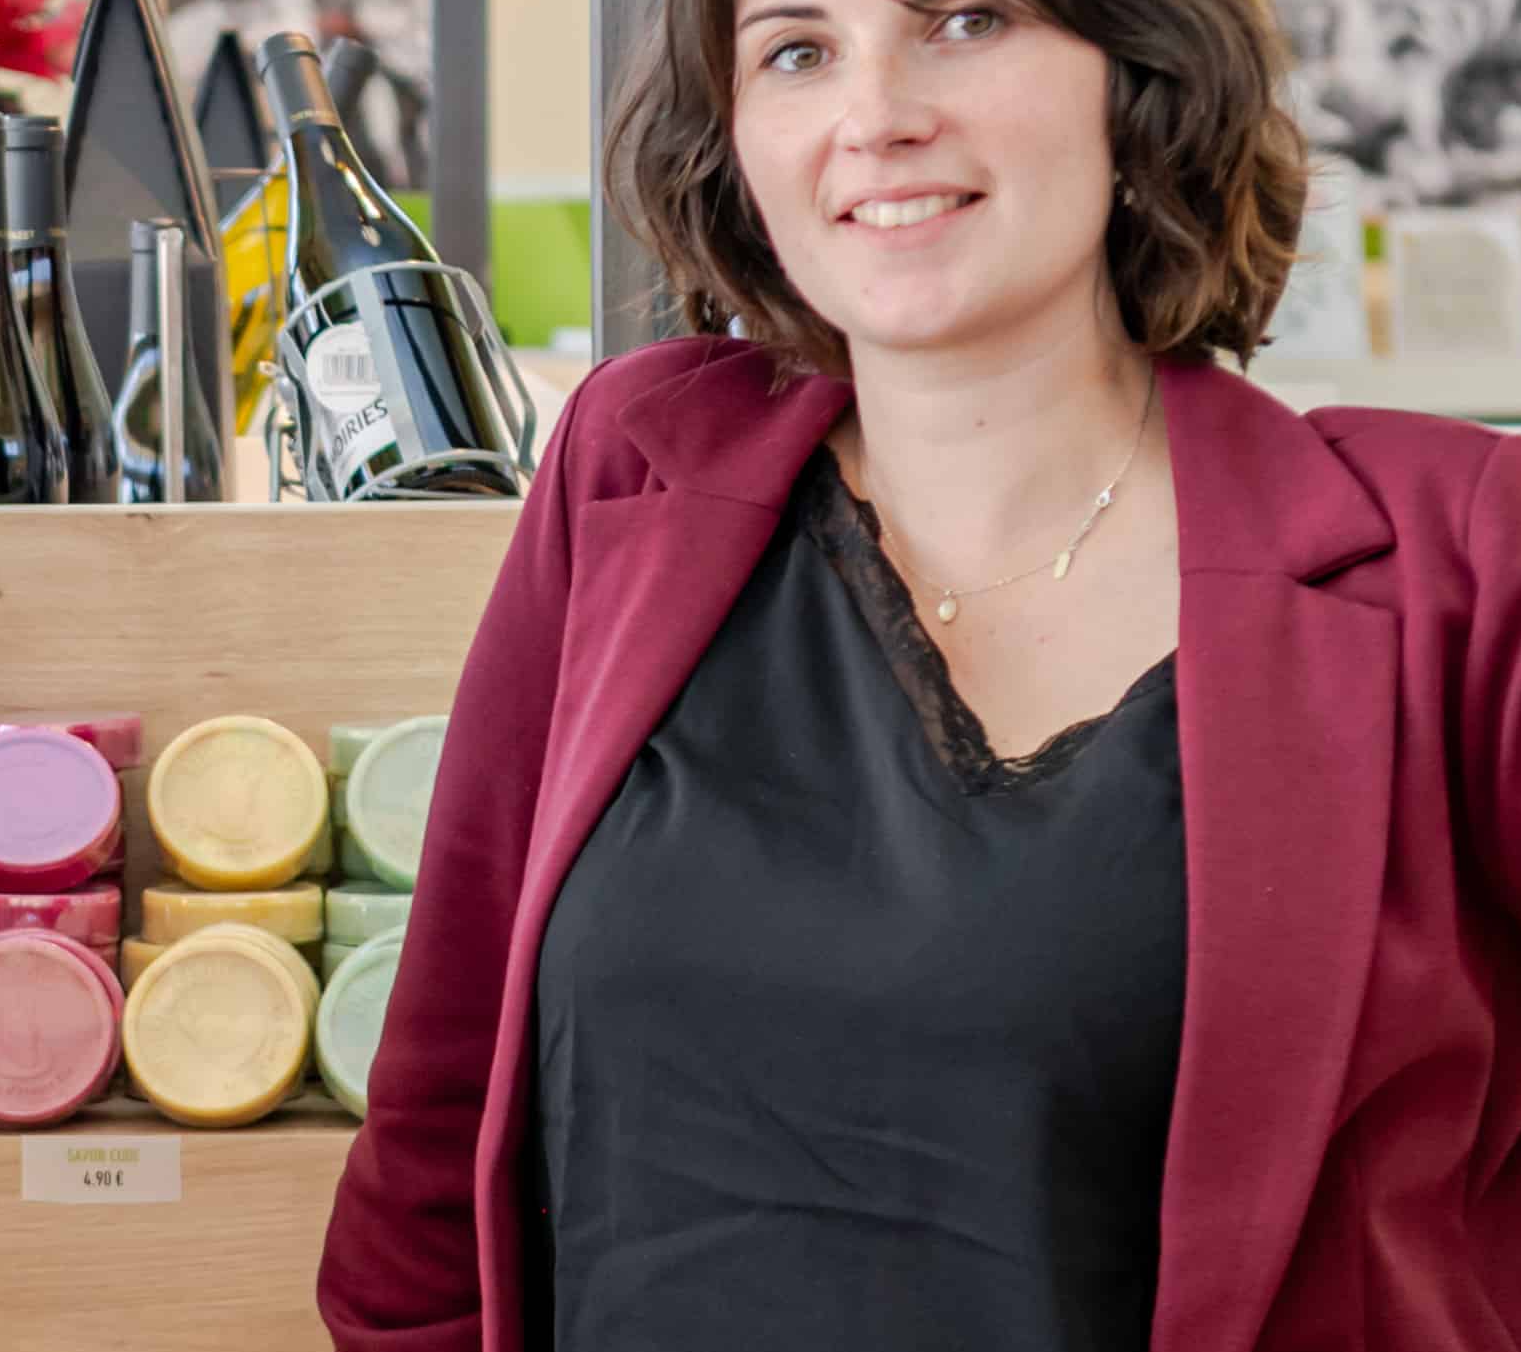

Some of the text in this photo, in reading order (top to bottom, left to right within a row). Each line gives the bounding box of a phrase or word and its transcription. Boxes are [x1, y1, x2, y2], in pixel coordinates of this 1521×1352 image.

[330, 397, 389, 458] OIRIES
[83, 1169, 125, 1187] 4.90 €
